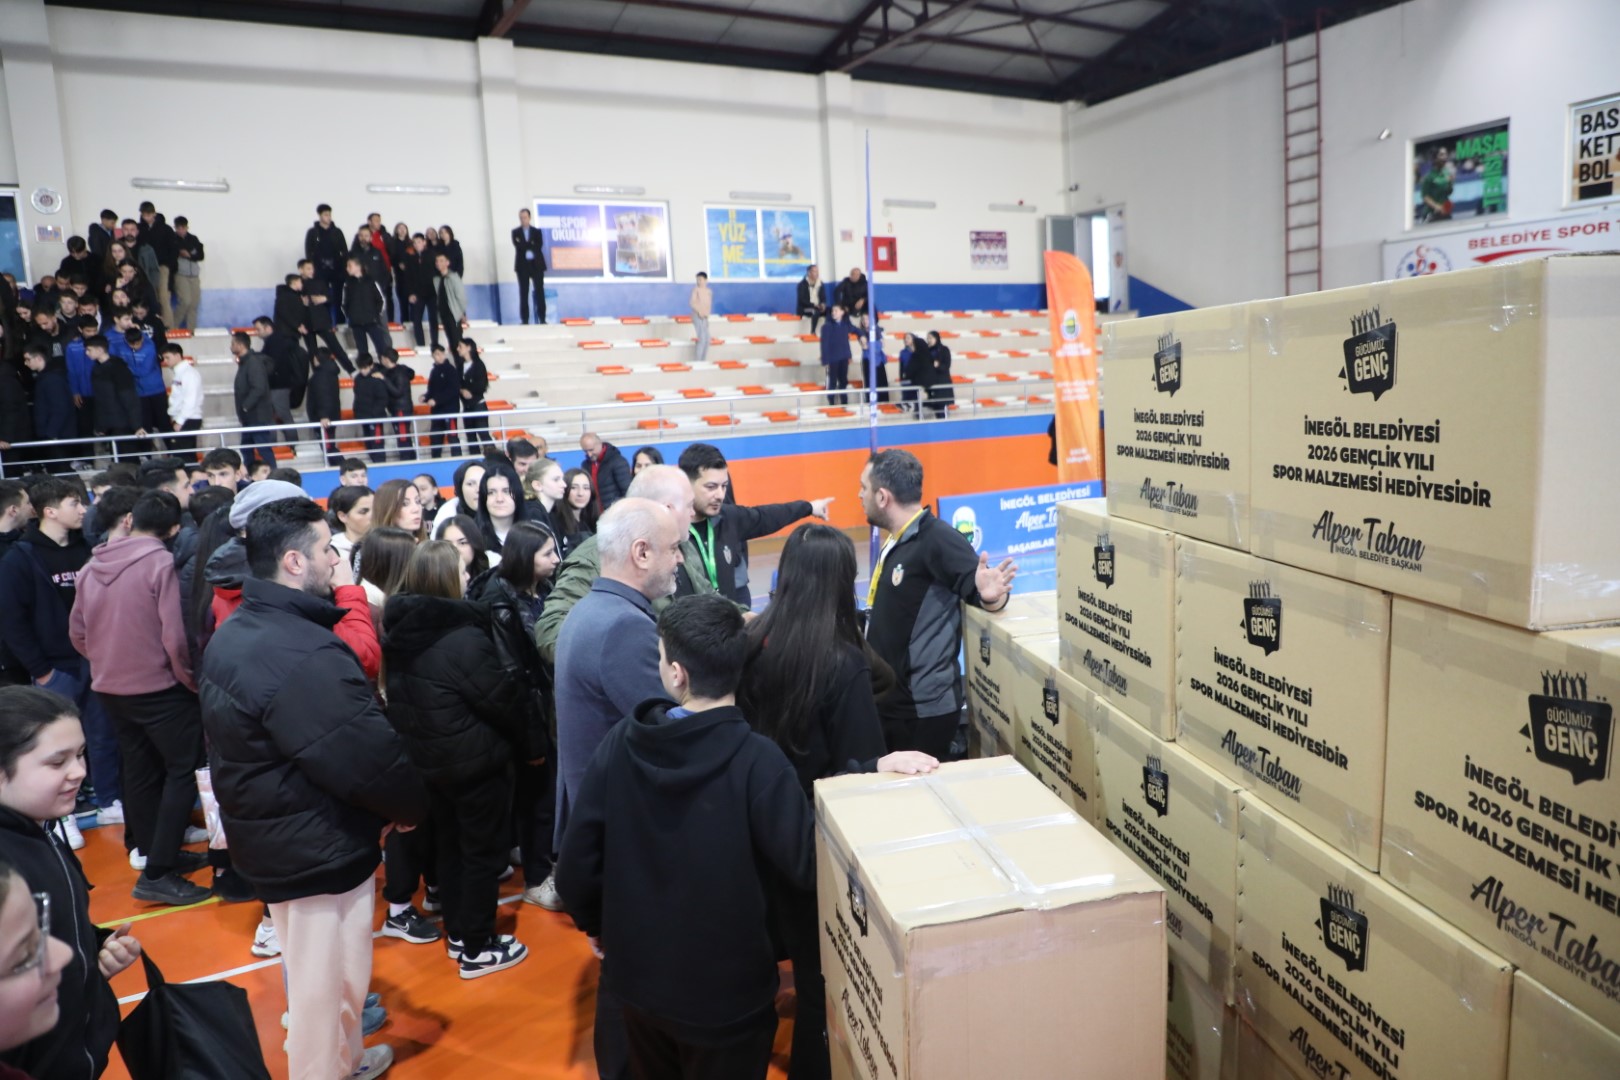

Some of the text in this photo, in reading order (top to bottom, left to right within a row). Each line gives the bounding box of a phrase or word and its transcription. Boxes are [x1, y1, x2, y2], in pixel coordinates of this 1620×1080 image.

[1580, 107, 1620, 135] BAS
[1455, 131, 1509, 160] MASA
[1580, 135, 1613, 159] KET
[1579, 159, 1614, 184] BOL
[560, 216, 587, 229] SPOR
[718, 222, 746, 242] YÜZ
[1468, 230, 1551, 250] BELEDİYE
[1557, 222, 1610, 238] SPOR
[722, 245, 745, 263] ME
[1160, 362, 1178, 384] GENÇ
[1354, 351, 1389, 382] GENÇ
[1134, 408, 1204, 427] İNEGÖL BELEDİYESİ
[1304, 414, 1440, 443] İNEGÖL BELEDİYESİ
[1136, 429, 1202, 447] 2026 GENÇLİK YILI
[1117, 445, 1230, 471] SPOR MALZEMESİ HEDİYESİDİR
[1308, 444, 1435, 472] 2026 GENÇLİK YILI
[1000, 485, 1091, 511] İNEGÖL BELEDİYESİ
[1140, 477, 1199, 511] Alper Taban
[1273, 464, 1491, 508] SPOR MALZEMESİ HEDİYESİDİR
[1015, 510, 1045, 532] Alper
[1312, 510, 1426, 562] Alper Taban
[1098, 599, 1132, 624] BELEDİYESİ
[1118, 624, 1131, 641] YILI
[1251, 617, 1277, 642] GENÇ
[1214, 646, 1312, 707] İNEGÖL BELEDİYESİ
[1216, 672, 1308, 727] 2026 GENÇLİK YILI
[1190, 678, 1348, 770] SPOR MALZEMESİ HEDİYESİDİR
[1546, 706, 1593, 730] GÜCÜMÜZ
[1544, 723, 1599, 766] GENÇ
[1221, 729, 1303, 794] Alper Taban
[1147, 783, 1166, 808] GENÇ
[1464, 755, 1620, 848] İNEGÖL BELEDİ
[1122, 797, 1190, 867] İNEGÖL BELEDİYESİ
[1467, 790, 1612, 880] 2026 GENÇLİK
[1124, 818, 1187, 882] 2026 GENÇLİK YILI
[1414, 789, 1620, 918] SPOR MALZEMESİ HE
[1106, 818, 1122, 840] SPOR
[1122, 834, 1163, 879] MALZEMESİ
[1163, 869, 1213, 924] HEDİYESİDİR
[1470, 875, 1548, 937] Alper
[1329, 921, 1361, 960] GENÇ
[1504, 921, 1538, 952] İNEGÖL
[1541, 945, 1587, 982] BELEDİYE
[1252, 951, 1280, 986] SPOR
[1282, 977, 1353, 1052] MALZEMESİ
[1282, 931, 1405, 1050] İNEGÖL BELEDİYESİ
[1285, 960, 1399, 1070] 2026 GENÇLİK YILI
[1289, 1026, 1335, 1077] Alper
